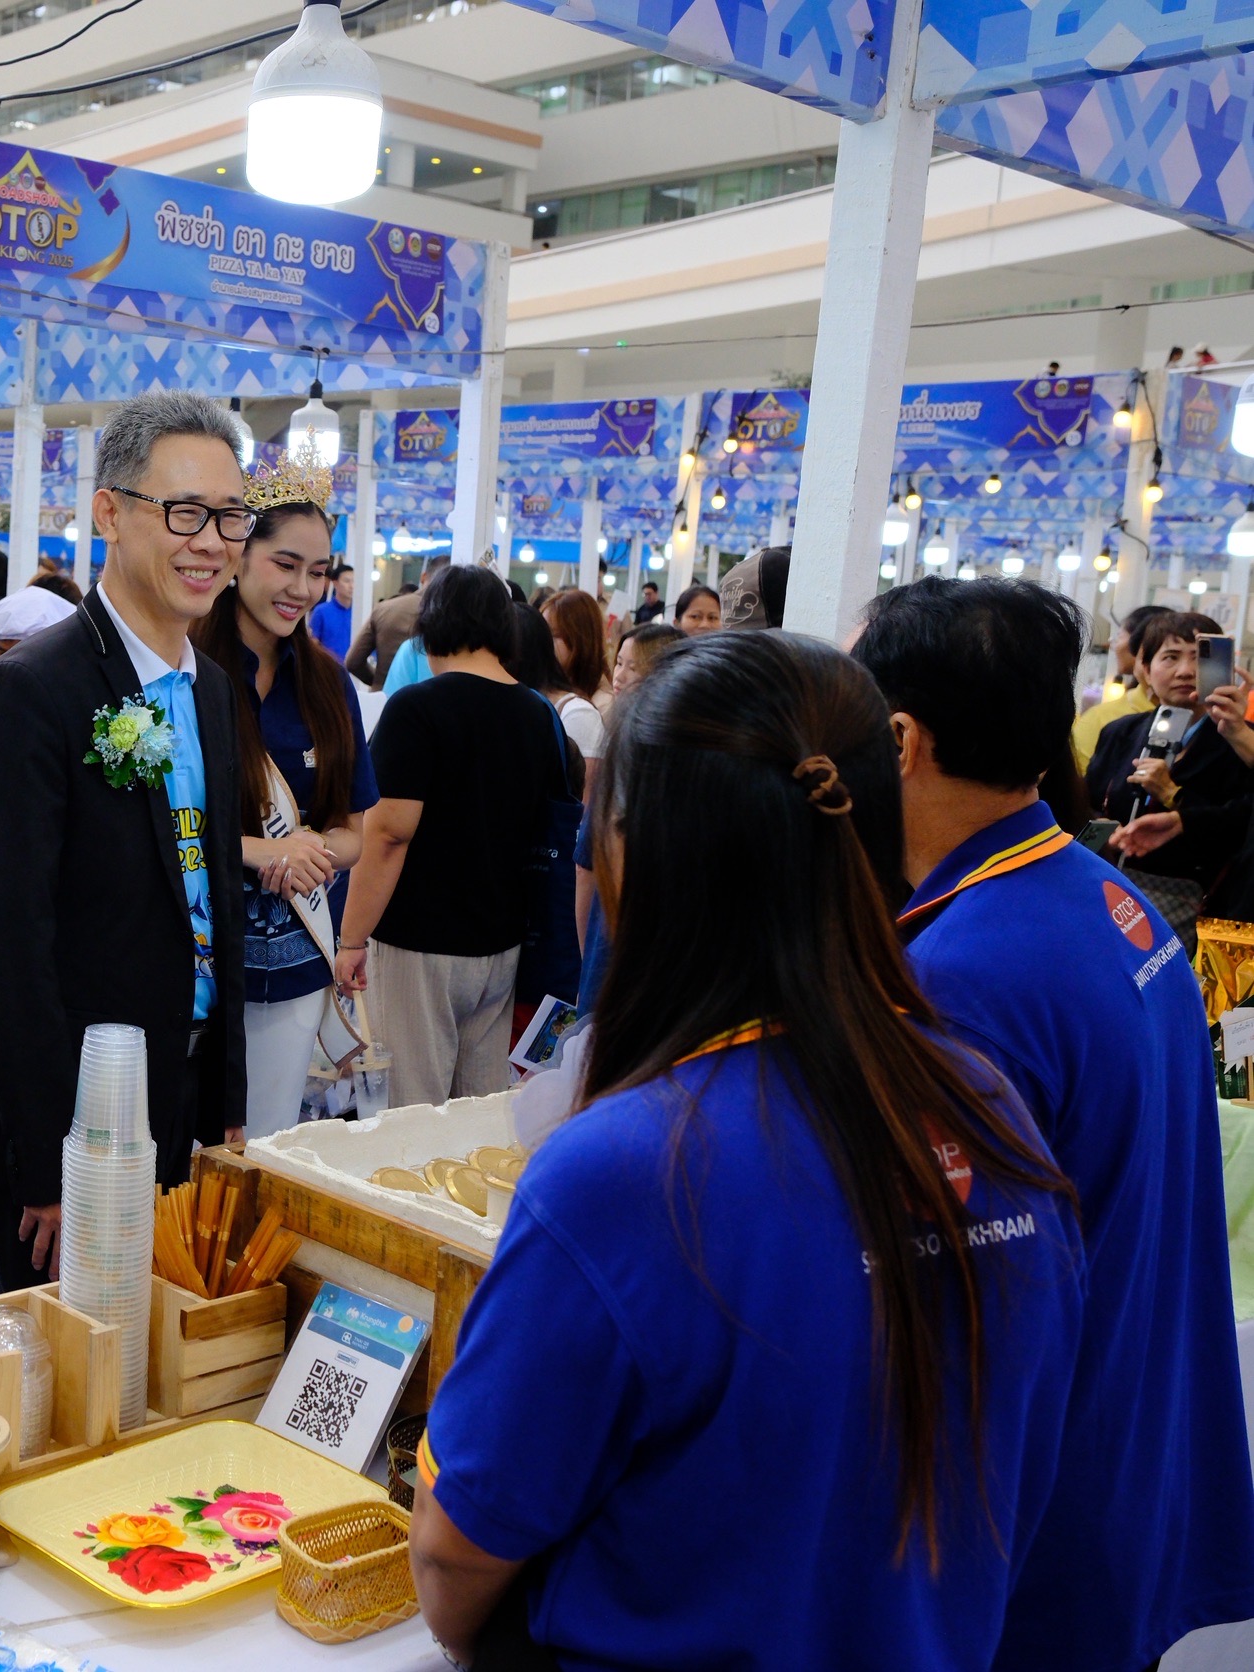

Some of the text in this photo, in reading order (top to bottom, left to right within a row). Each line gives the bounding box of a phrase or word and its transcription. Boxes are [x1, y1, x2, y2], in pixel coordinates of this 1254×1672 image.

[155, 200, 226, 250] พิซซ่า
[233, 225, 266, 258] ตา
[273, 233, 305, 263] กะ
[310, 239, 356, 273] ยาย
[48, 253, 74, 268] 2025
[209, 254, 306, 285] PIZZA TA ka YAY
[737, 419, 797, 440] OTOP
[399, 433, 445, 451] OTOP
[1111, 896, 1135, 925] OTOP
[360, 1312, 387, 1328] Krungthai
